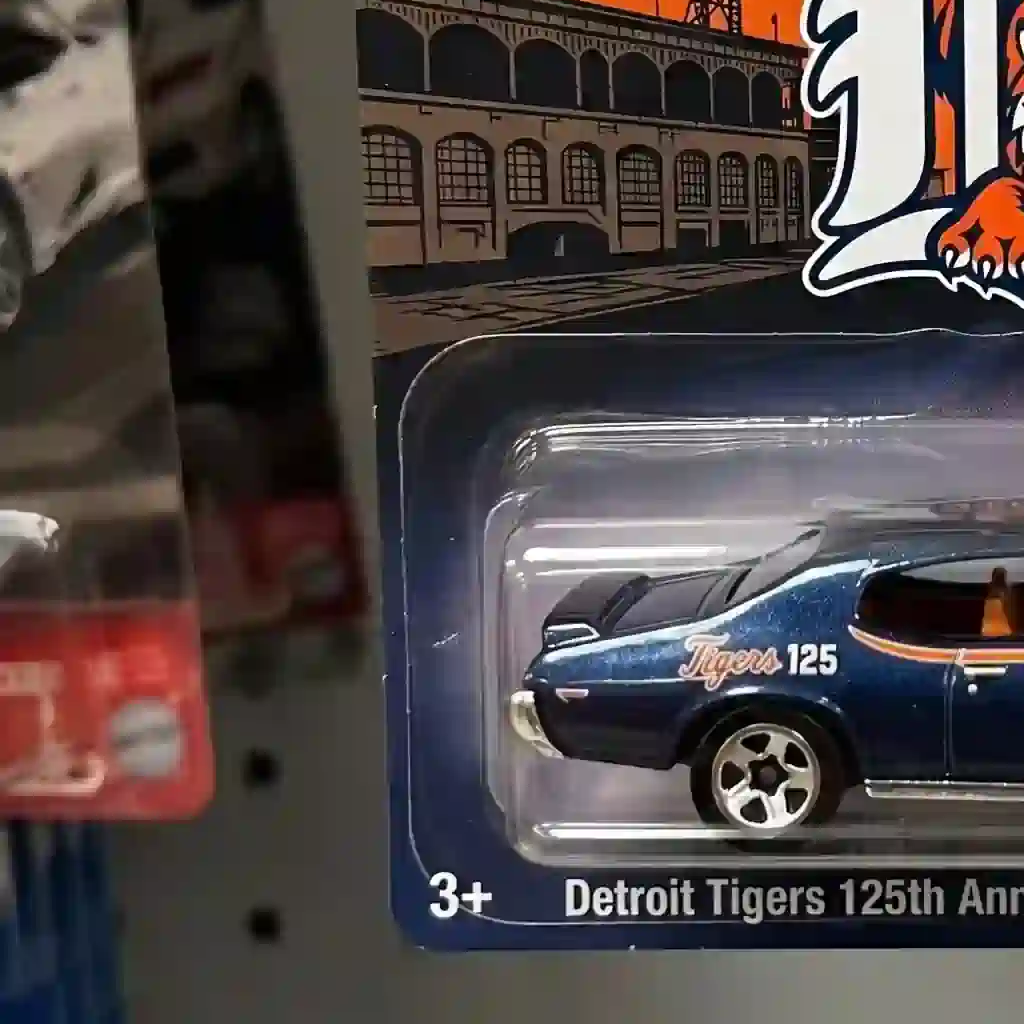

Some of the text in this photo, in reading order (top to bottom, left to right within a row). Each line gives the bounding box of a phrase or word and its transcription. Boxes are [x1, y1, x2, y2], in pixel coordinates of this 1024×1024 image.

[677, 631, 838, 692] Tigers 125
[428, 871, 493, 919] 3+
[565, 878, 696, 917] Detroit
[706, 878, 826, 925] Tigers
[839, 878, 945, 916] 125th
